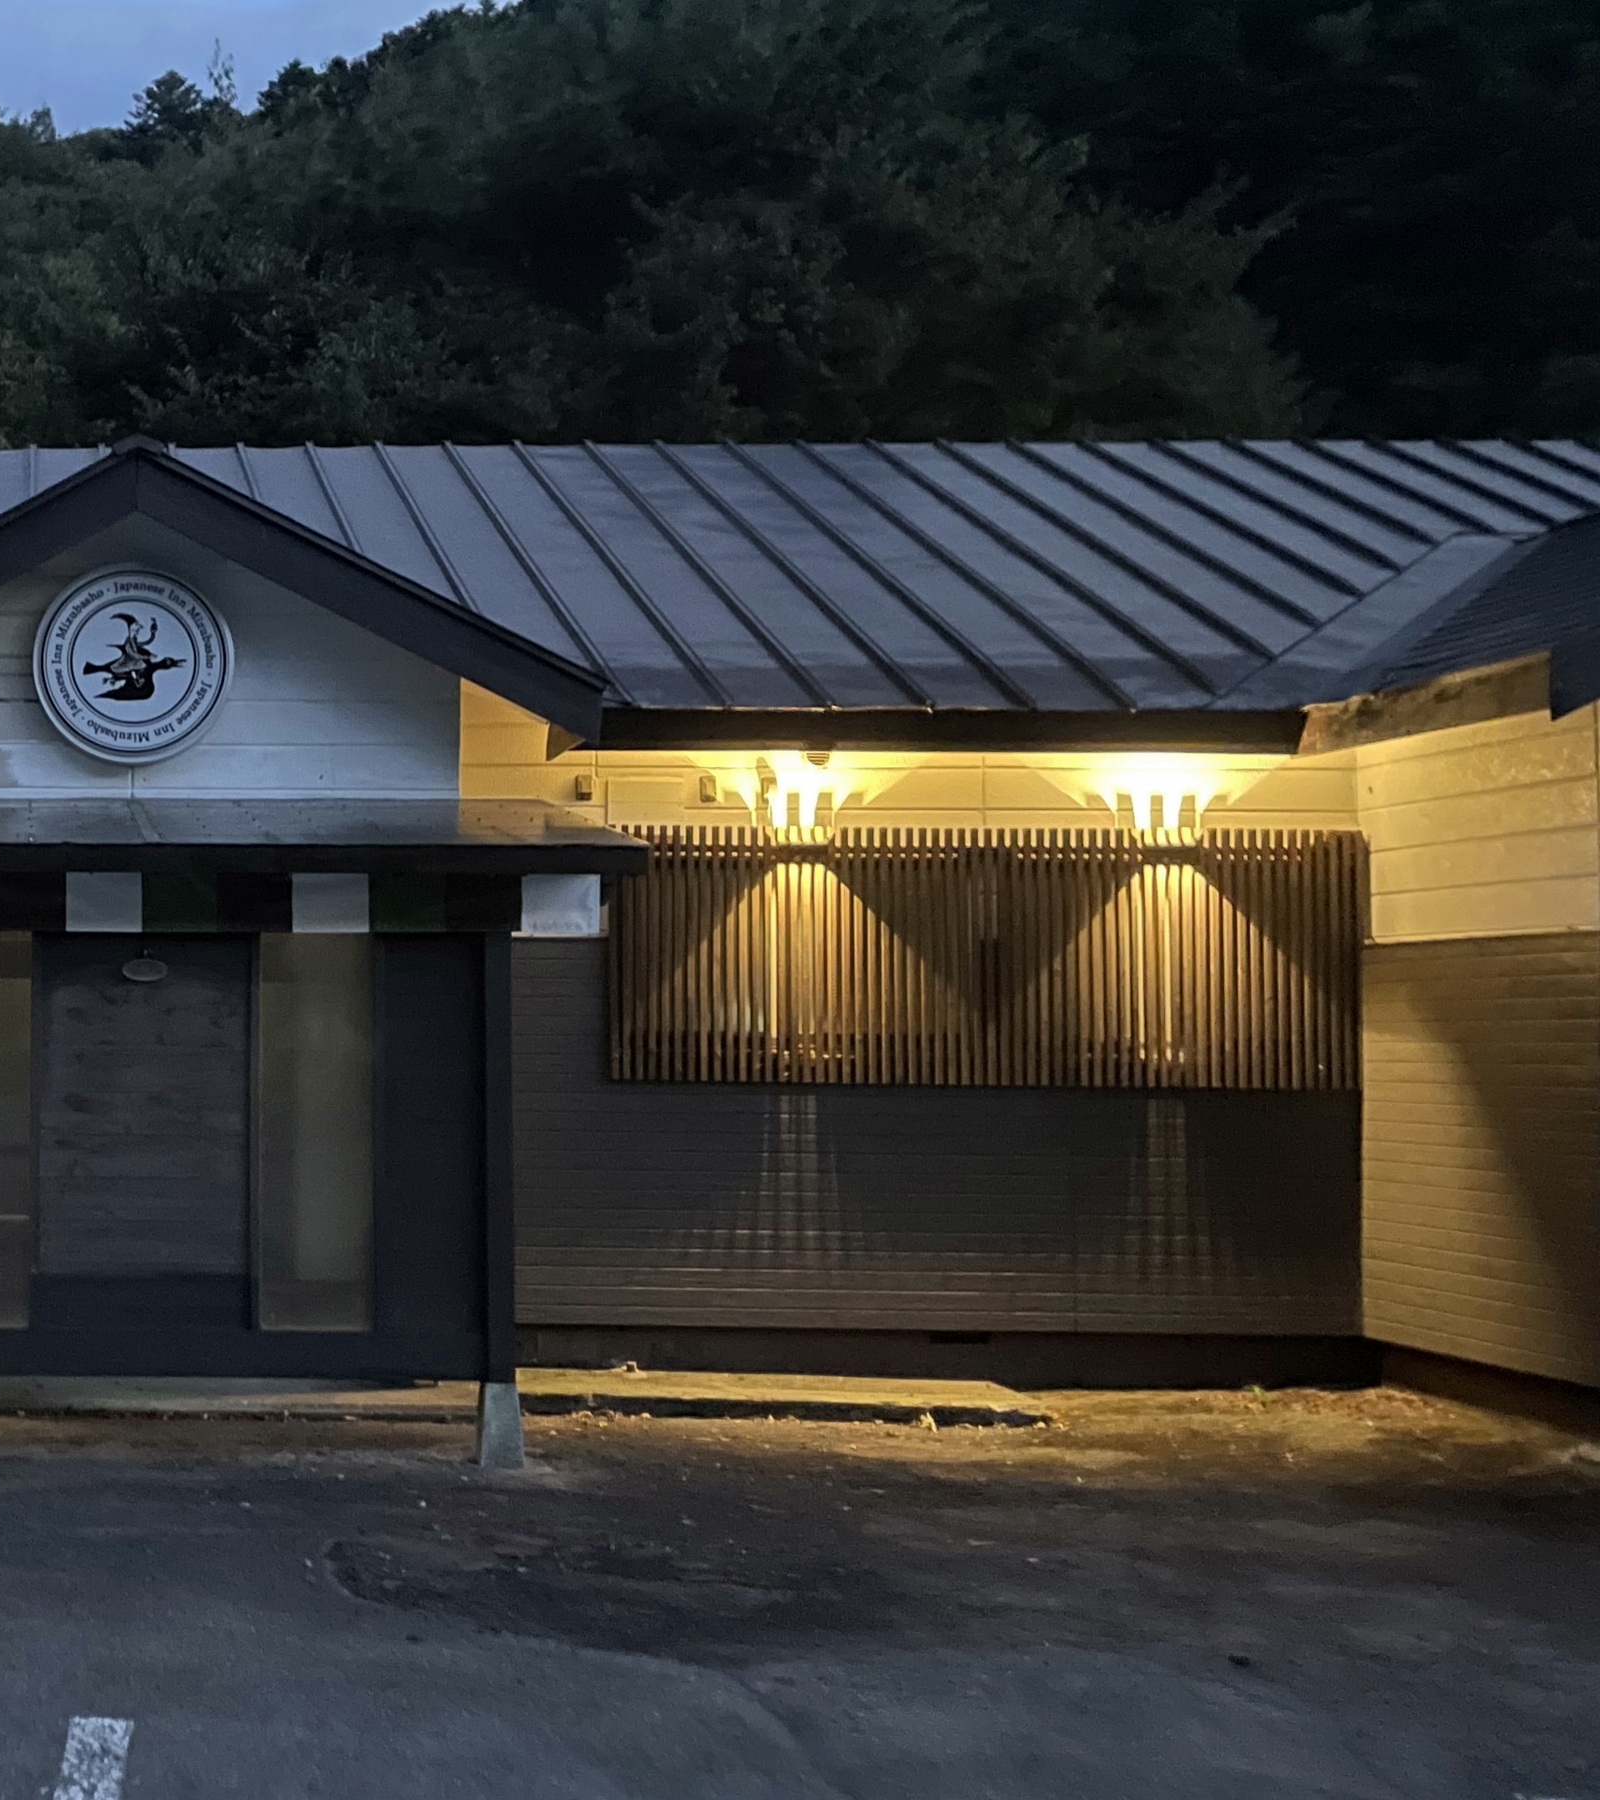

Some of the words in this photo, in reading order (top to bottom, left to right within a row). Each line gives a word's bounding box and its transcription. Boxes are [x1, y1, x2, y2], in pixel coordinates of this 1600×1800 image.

[55, 588, 104, 641] Mizubasho
[113, 581, 165, 595] Japanese
[167, 589, 187, 610] Inn
[187, 606, 217, 670] Mizubasho
[51, 644, 63, 665] Inn
[53, 668, 83, 718] Japanese
[176, 680, 212, 725] Japanese
[87, 718, 150, 743] Mizubasho
[153, 721, 176, 737] Inn
